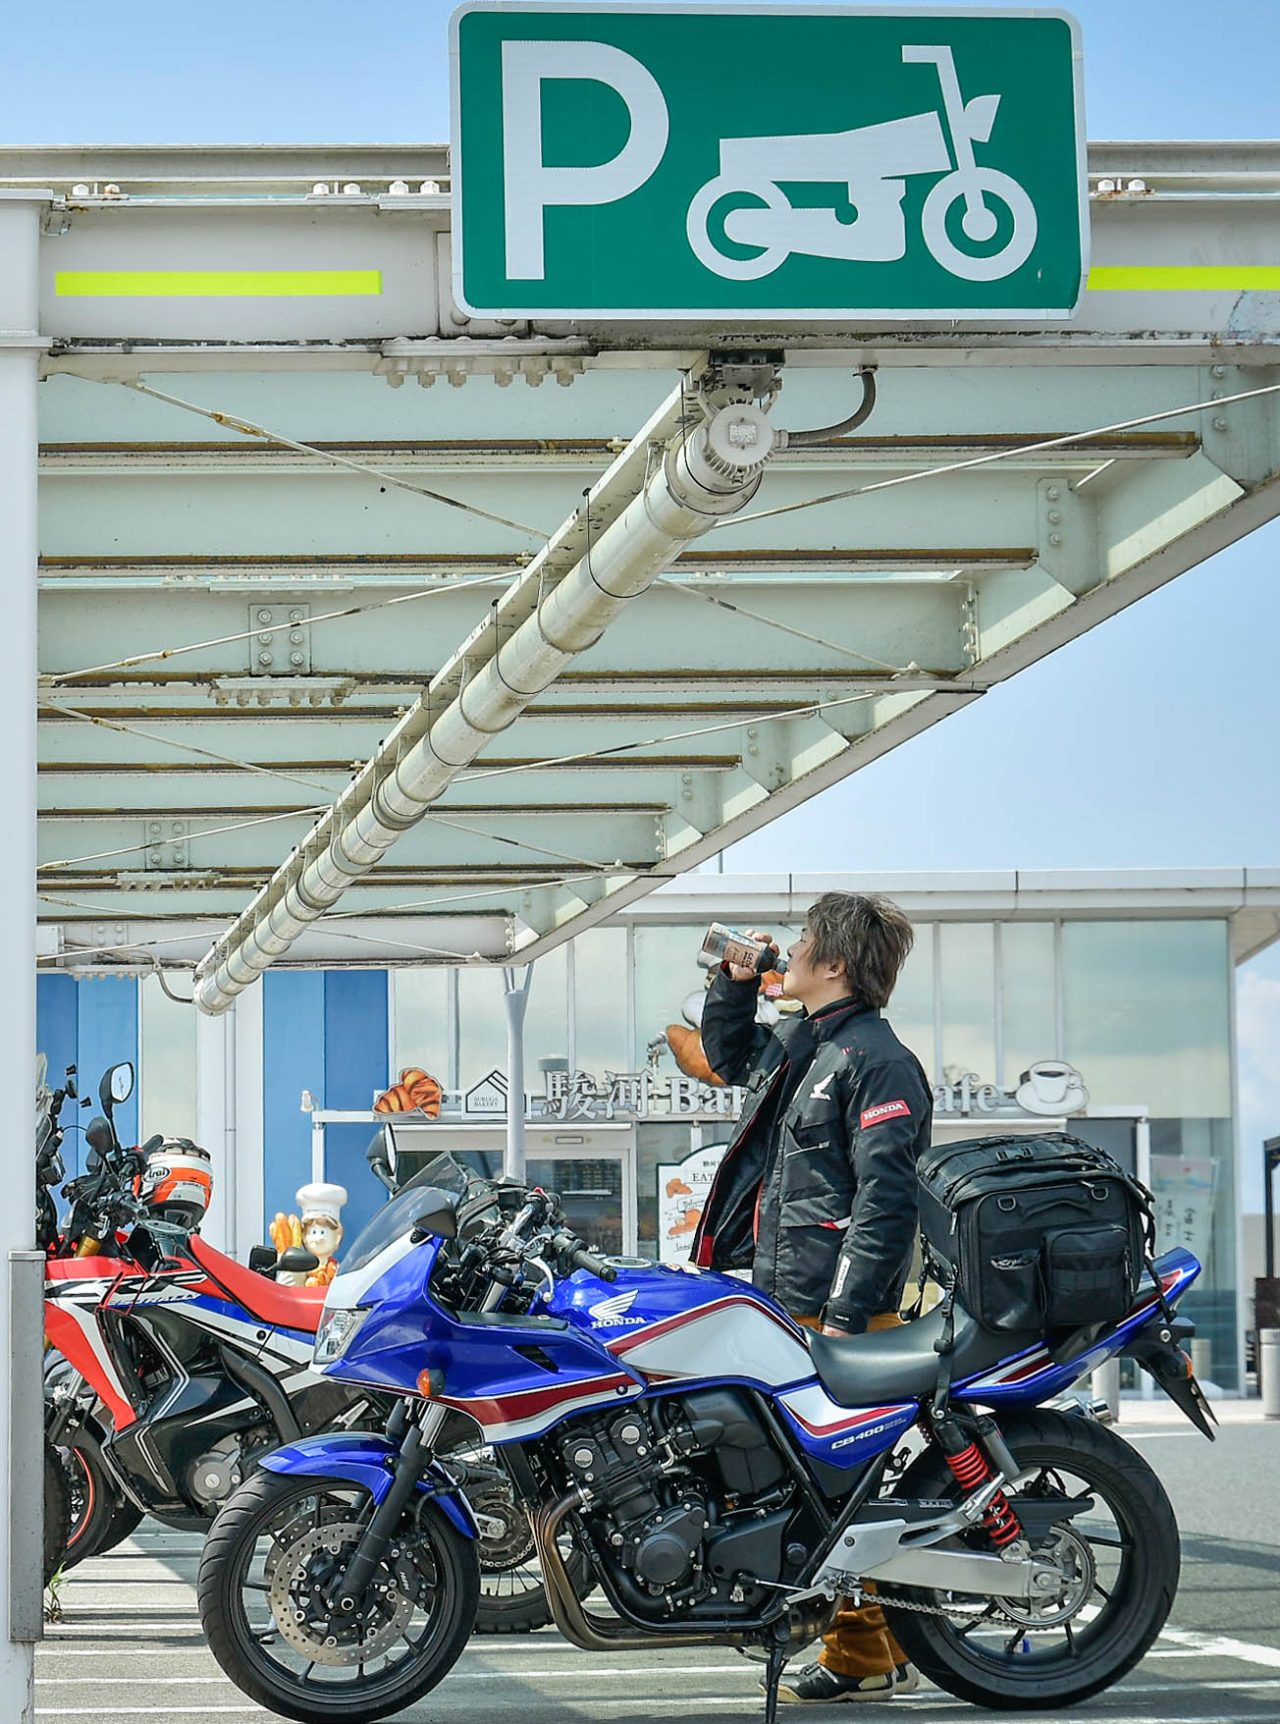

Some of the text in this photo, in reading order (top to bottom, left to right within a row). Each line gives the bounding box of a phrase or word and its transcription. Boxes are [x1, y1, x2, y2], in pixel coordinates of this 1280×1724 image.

[501, 39, 669, 280] P
[542, 1069, 653, 1119] 駿河
[933, 1073, 1000, 1113] afe
[864, 1103, 904, 1120] HONDA
[591, 1316, 647, 1330] HONDA
